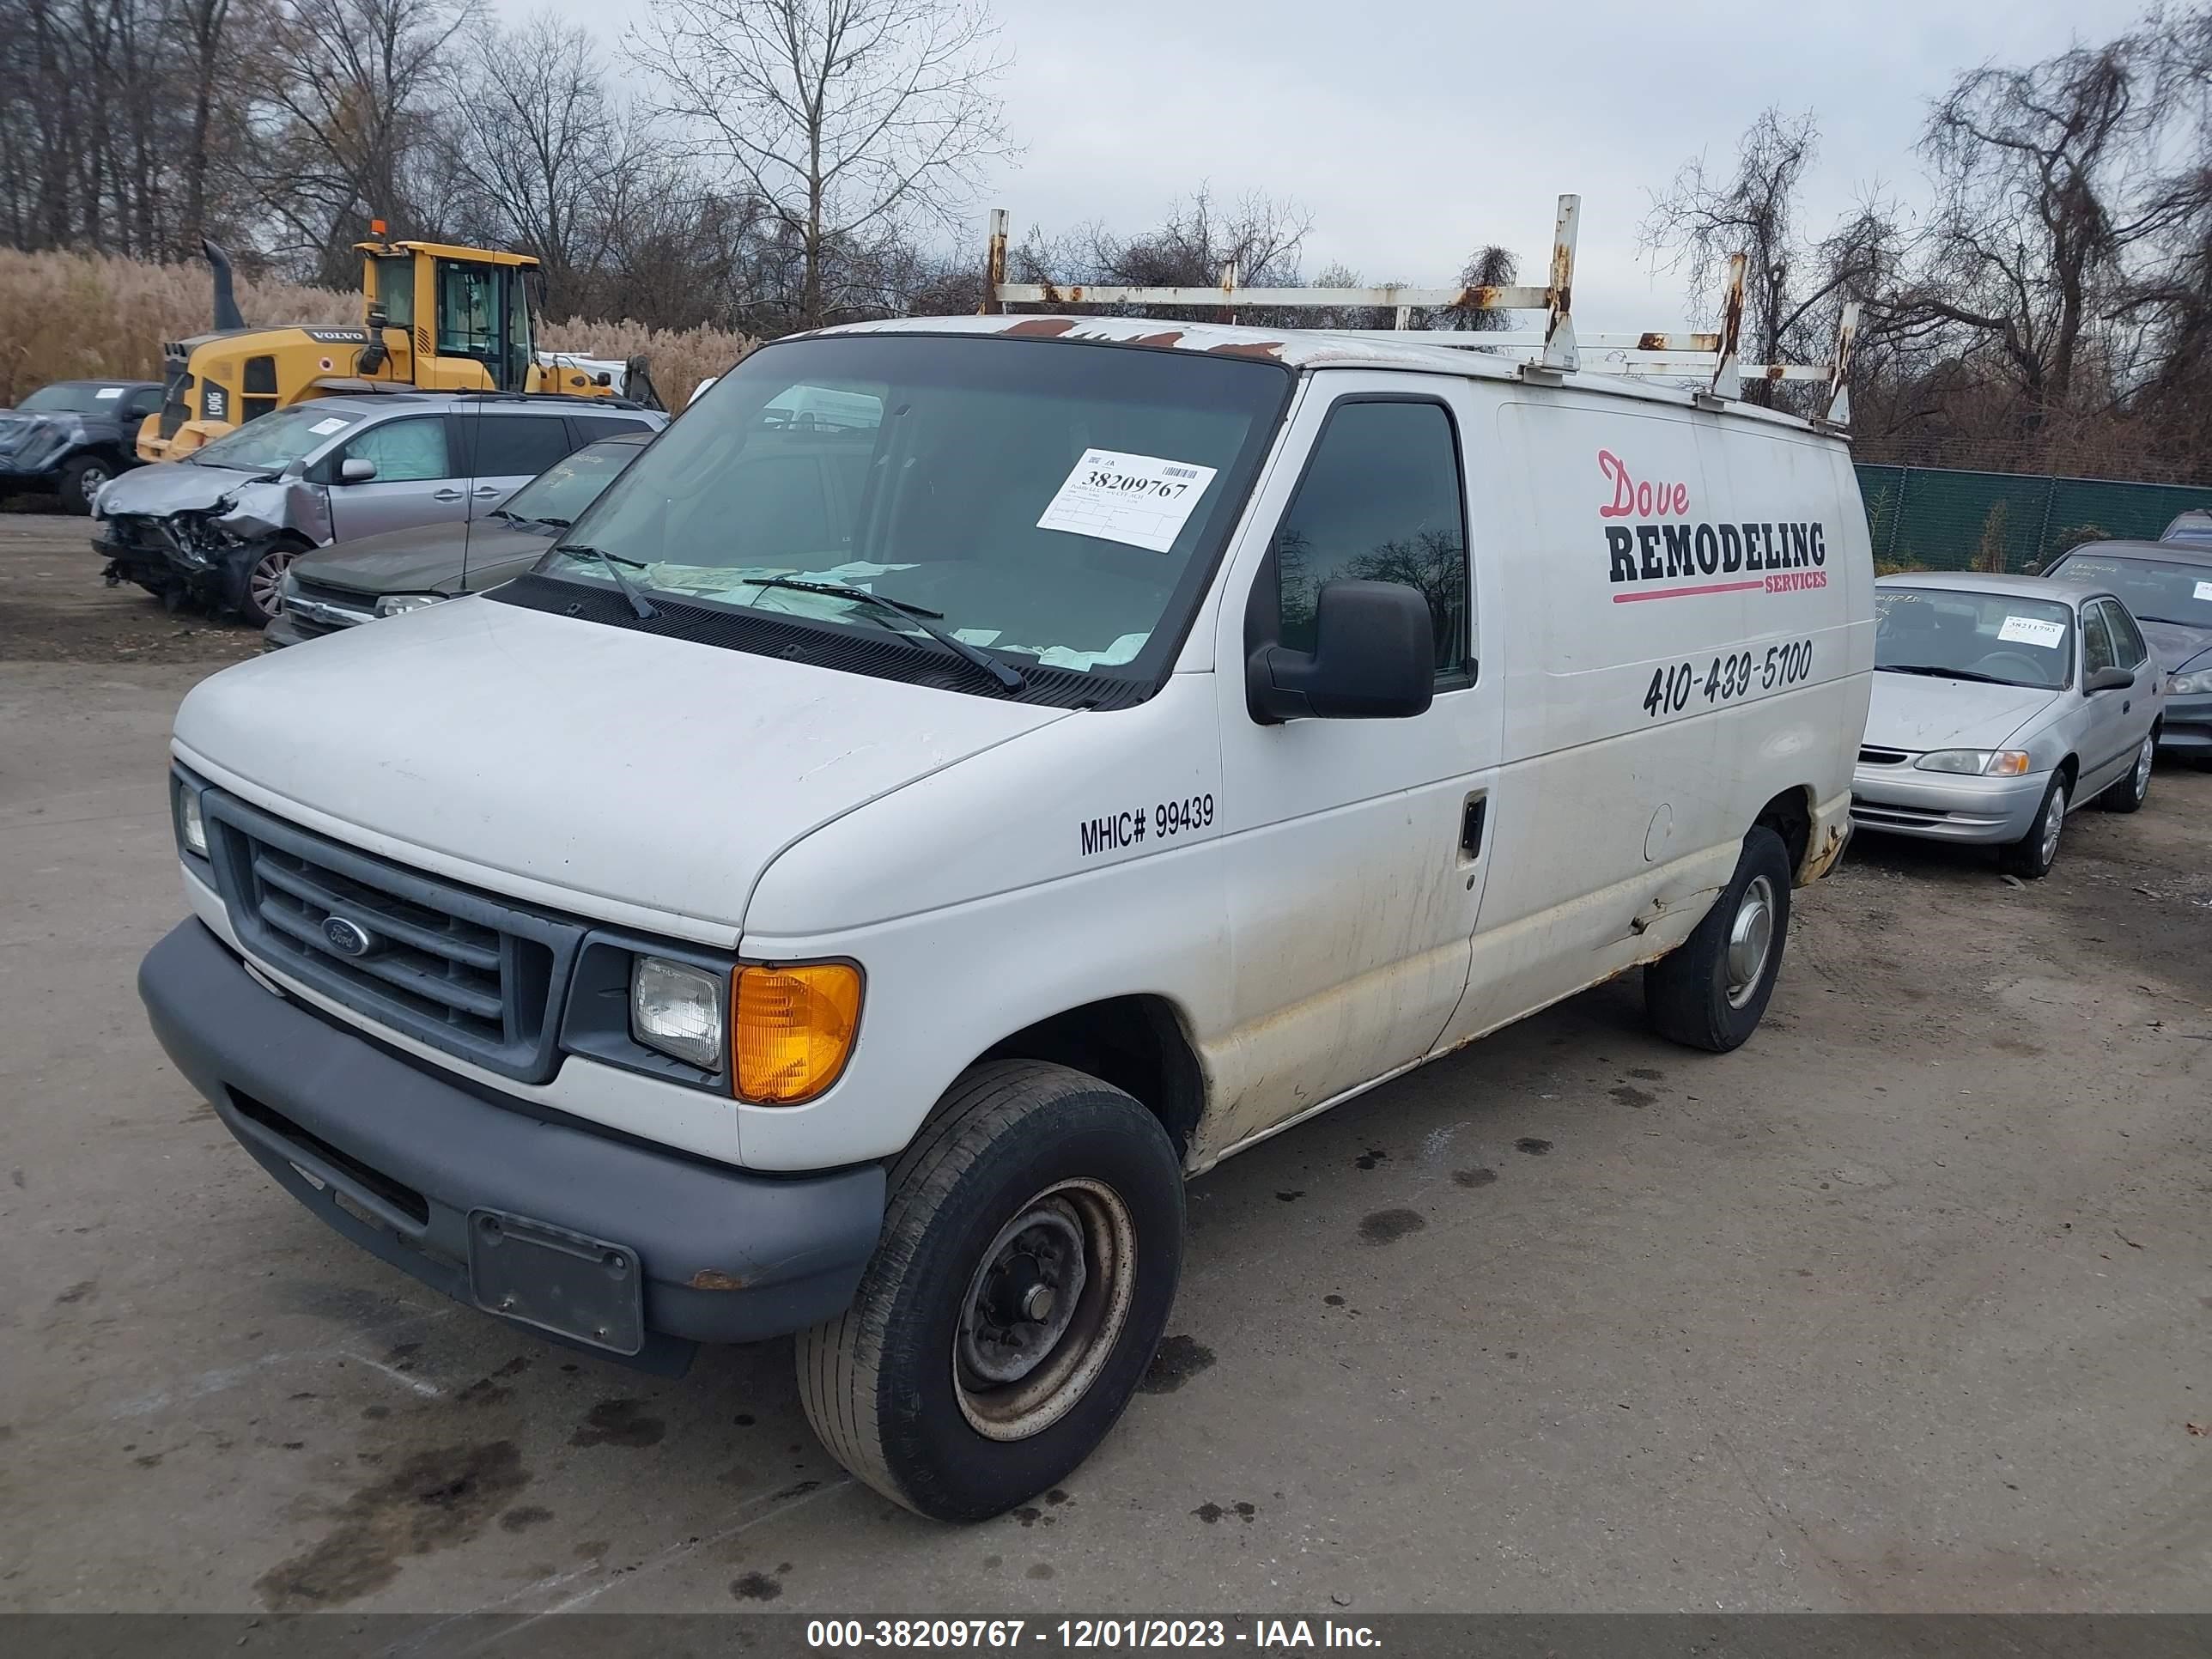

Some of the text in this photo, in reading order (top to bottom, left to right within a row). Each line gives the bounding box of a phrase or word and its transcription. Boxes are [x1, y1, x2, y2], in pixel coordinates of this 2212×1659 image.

[312, 331, 364, 340] VOLVO
[208, 392, 223, 416] L90G
[1082, 471, 1189, 501] 38209767
[1598, 449, 1690, 518] Dove
[1604, 521, 1826, 583] REMODELING
[1765, 571, 1827, 594] SERVICES
[1643, 640, 1813, 717] 410-439-5100
[1080, 793, 1214, 856] MHIC# 99439
[330, 924, 355, 949] Ford
